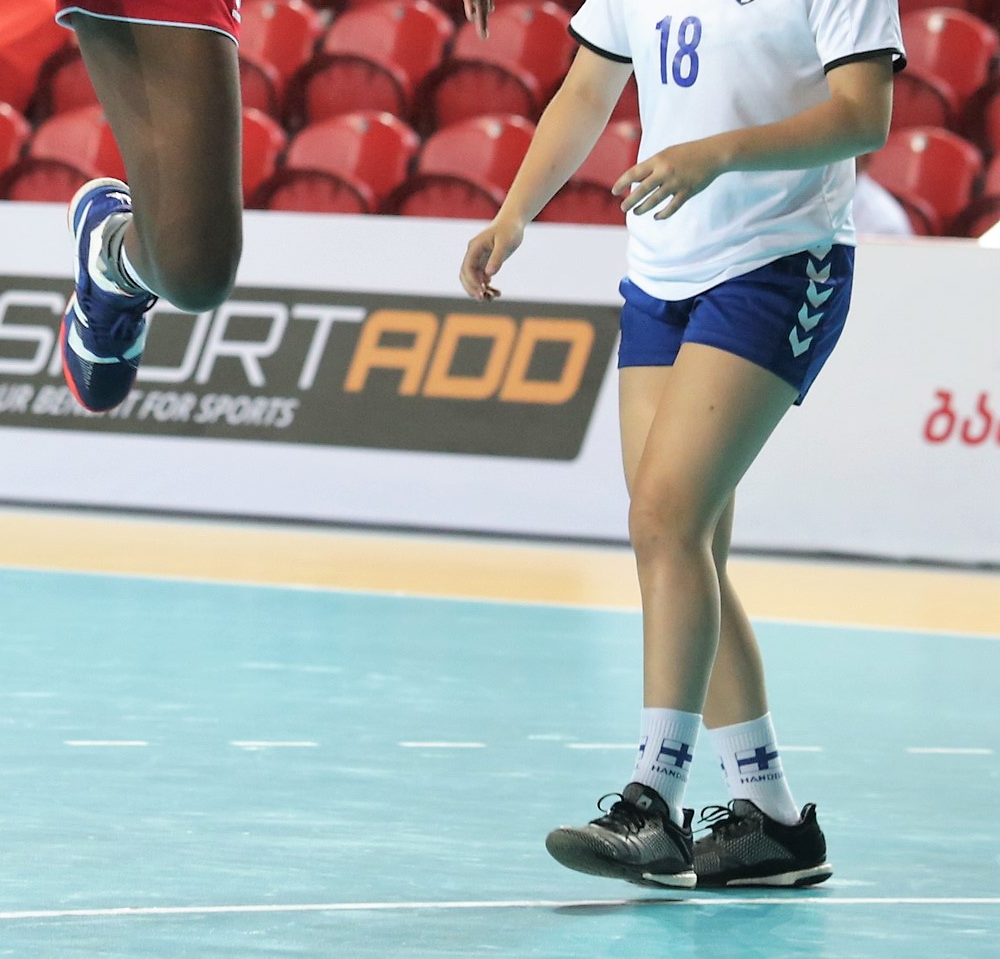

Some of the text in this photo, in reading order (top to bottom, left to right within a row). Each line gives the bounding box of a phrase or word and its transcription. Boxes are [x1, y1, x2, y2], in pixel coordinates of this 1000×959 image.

[655, 15, 702, 88] 18
[32, 384, 144, 419] BENIT
[136, 390, 198, 423] FOR
[194, 393, 299, 428] SPORTS
[922, 388, 1000, 445] ბა
